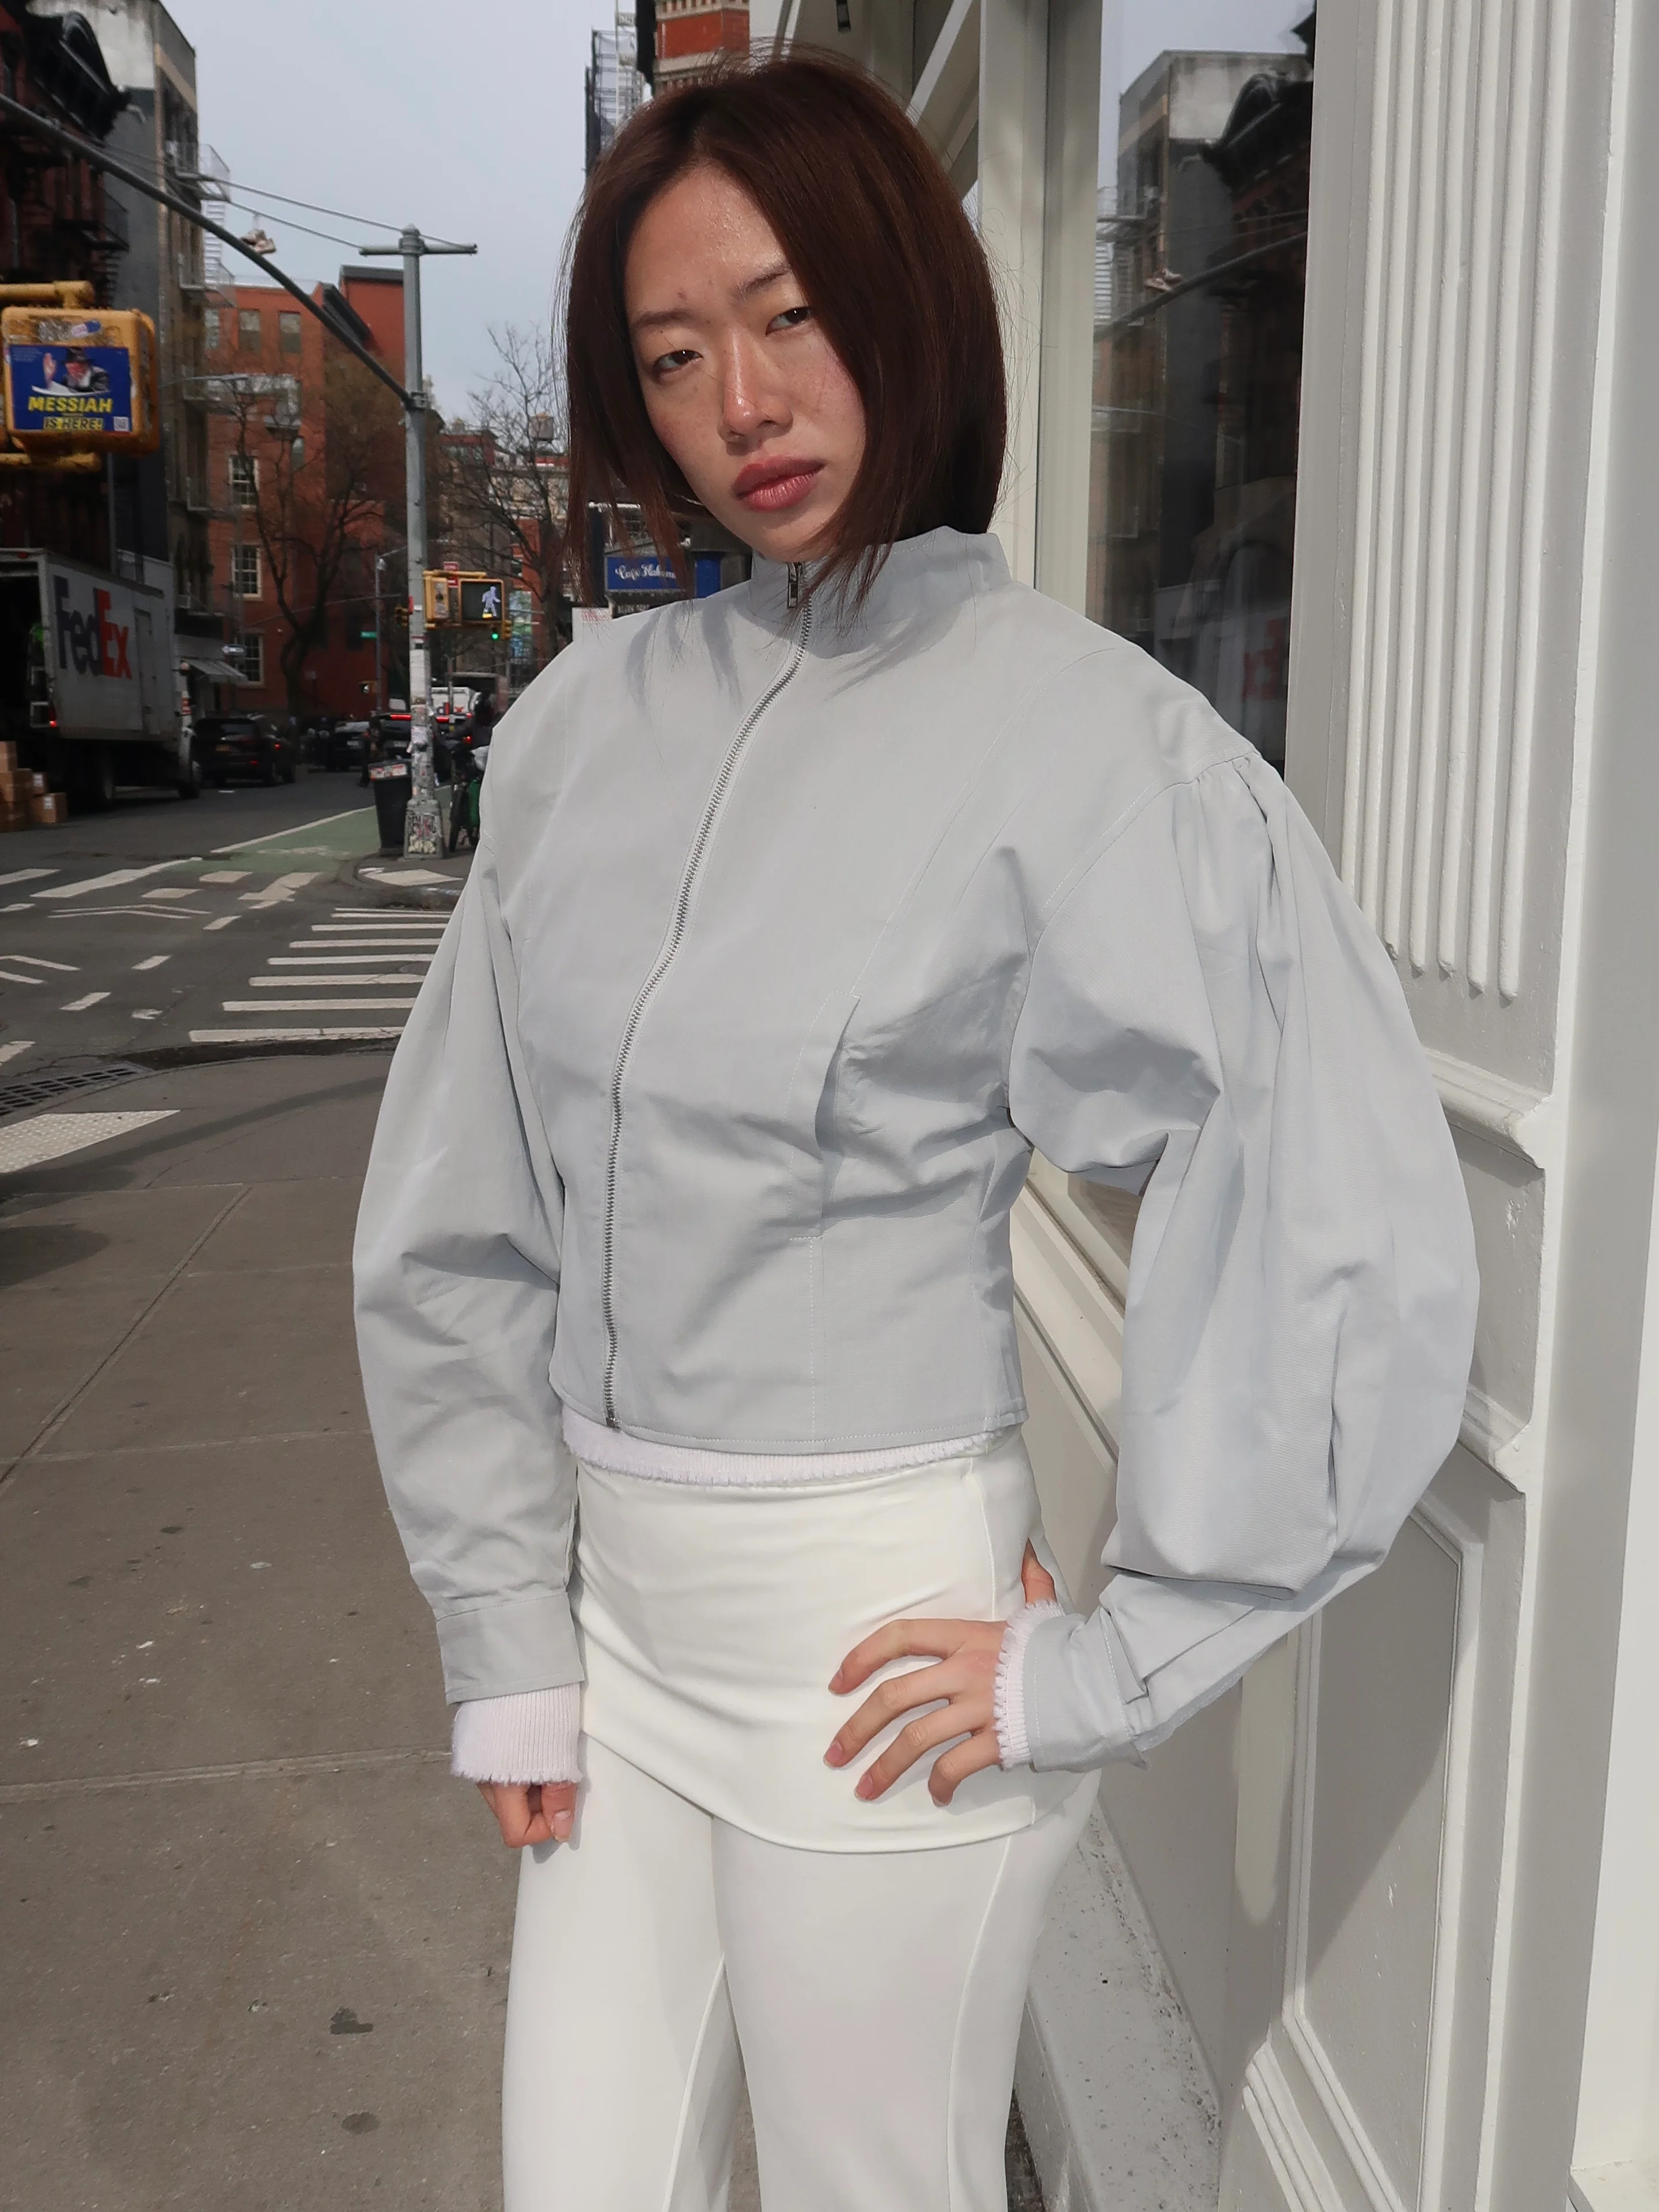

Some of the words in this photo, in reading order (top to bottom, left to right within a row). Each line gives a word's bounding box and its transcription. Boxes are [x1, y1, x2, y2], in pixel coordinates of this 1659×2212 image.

[28, 396, 113, 413] MESSIAH
[45, 418, 57, 429] IS
[53, 574, 132, 680] FedEx
